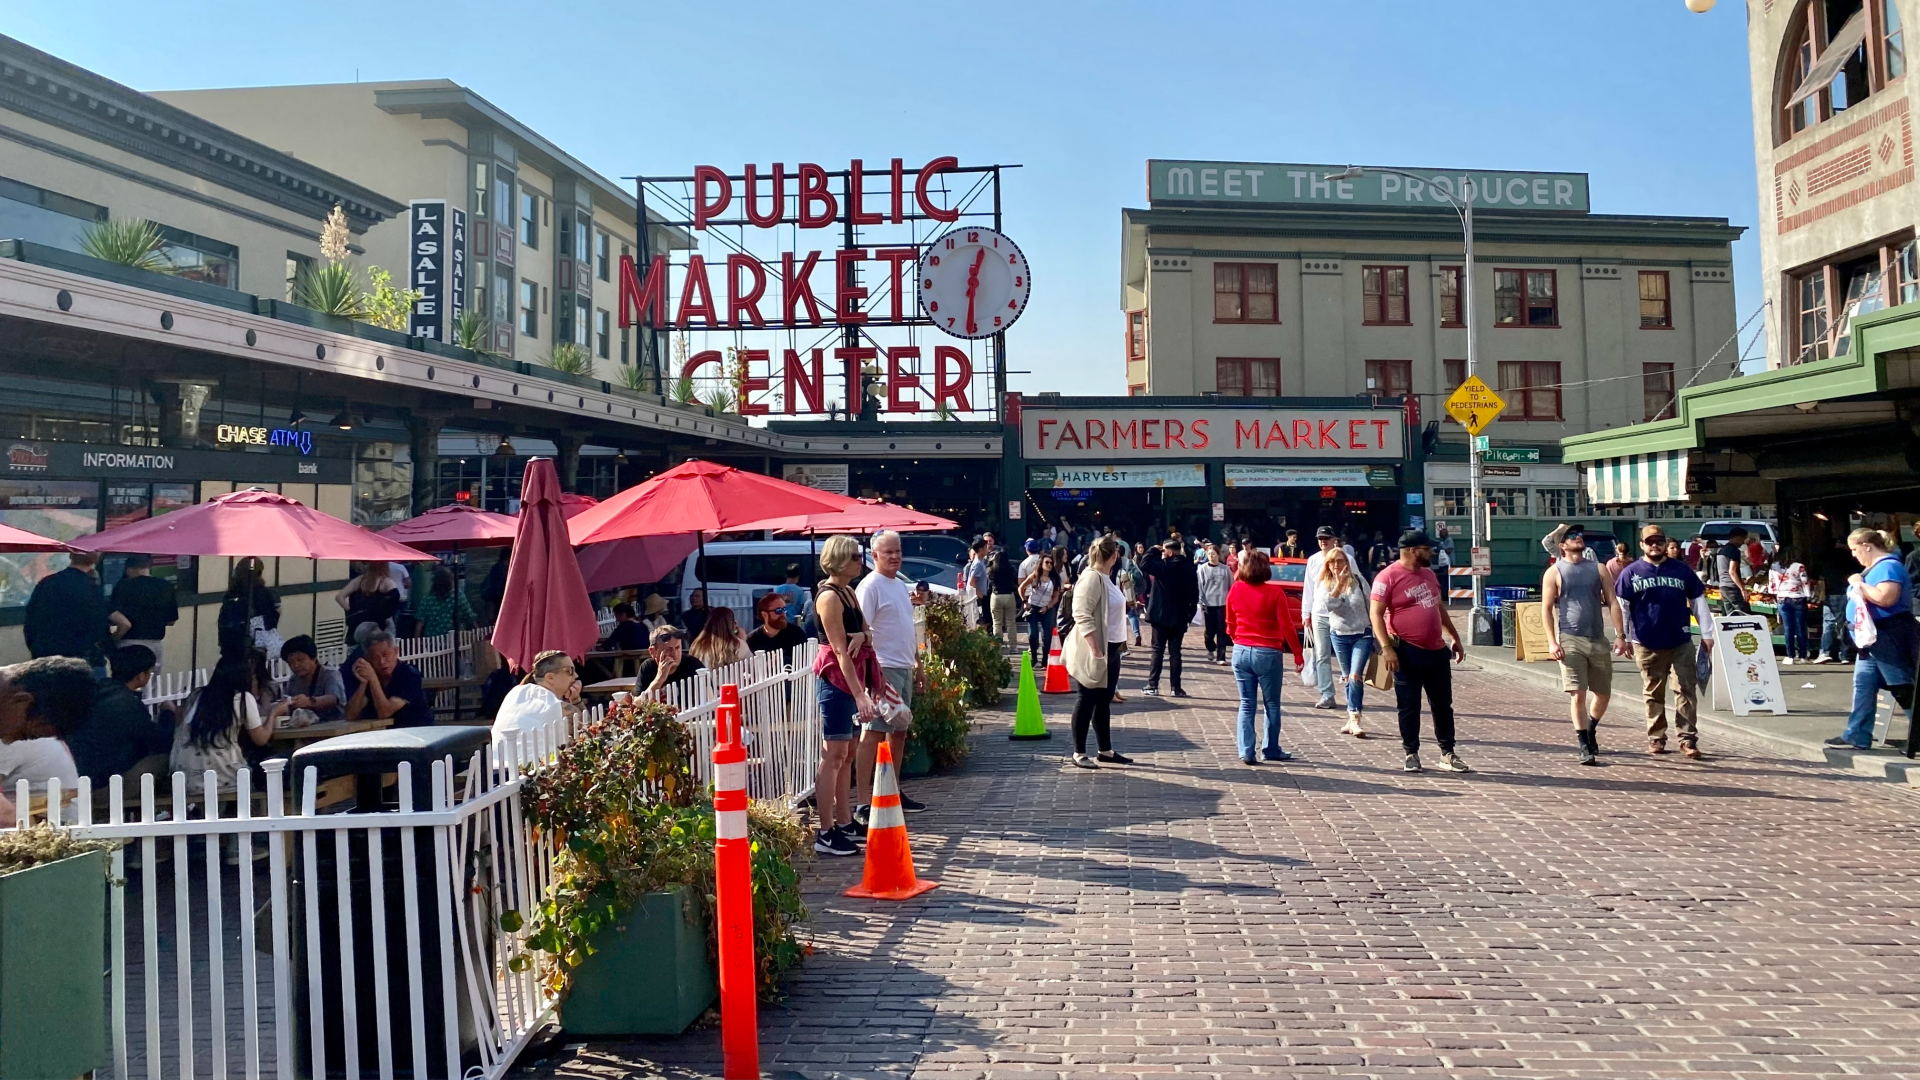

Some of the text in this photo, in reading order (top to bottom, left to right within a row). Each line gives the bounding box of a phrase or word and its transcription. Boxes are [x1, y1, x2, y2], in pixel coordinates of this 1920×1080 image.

[1168, 166, 1574, 206] MEET THE PRODUCER
[694, 156, 959, 231] PUBLIC
[416, 207, 438, 235] LA
[454, 212, 464, 242] LA
[967, 231, 979, 243] 12
[994, 237, 998, 248] 1
[945, 238, 955, 250] 11
[929, 255, 940, 266] 10
[1009, 253, 1017, 264] 2
[415, 241, 438, 315] SALLE
[924, 278, 932, 289] 9
[1015, 276, 1023, 287] 3
[618, 248, 920, 329] MARKET
[930, 301, 938, 312] 8
[1008, 299, 1017, 310] 4
[947, 317, 956, 328] 7
[994, 316, 1002, 327] 5
[682, 346, 974, 417] CENTER
[1464, 385, 1485, 393] YIELD
[217, 424, 299, 447] CHASE ATM
[1038, 418, 1391, 451] FARMERS MARKET
[83, 452, 174, 469] INFORMATION
[1486, 450, 1508, 460] Pike
[298, 462, 318, 474] bank
[1062, 470, 1200, 482] HARVEST FESTIVAL
[1632, 576, 1685, 593] MARINERS
